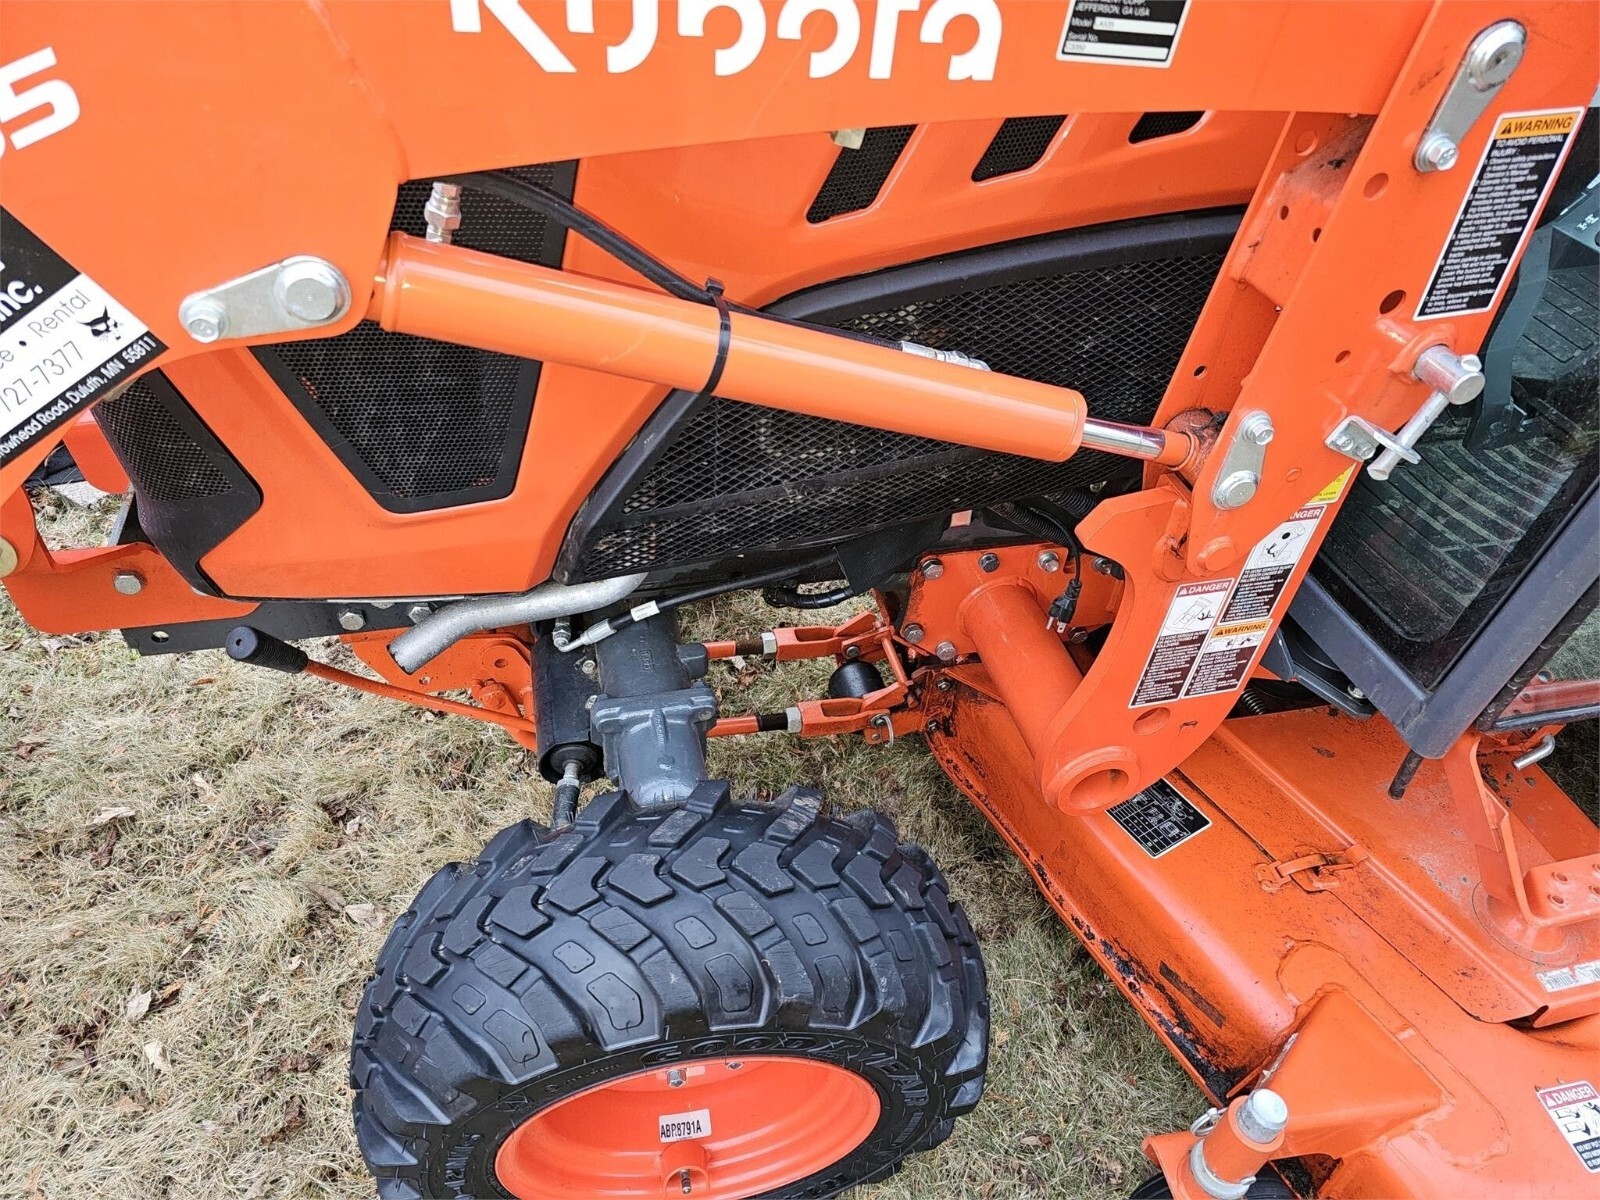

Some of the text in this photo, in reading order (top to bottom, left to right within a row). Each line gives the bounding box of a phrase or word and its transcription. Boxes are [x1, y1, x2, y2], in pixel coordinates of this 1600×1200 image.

[451, 0, 1002, 81] Kubota
[1514, 116, 1573, 132] WARNING
[27, 288, 91, 338] Rental
[36, 398, 73, 426] Road,
[65, 375, 108, 404] Duluth,
[100, 358, 126, 379] MN
[121, 335, 157, 364] 55811
[1290, 508, 1321, 520] NGER
[1188, 582, 1229, 594] DANGER
[1225, 623, 1265, 634] WARNING
[1552, 1085, 1594, 1104] DANGER
